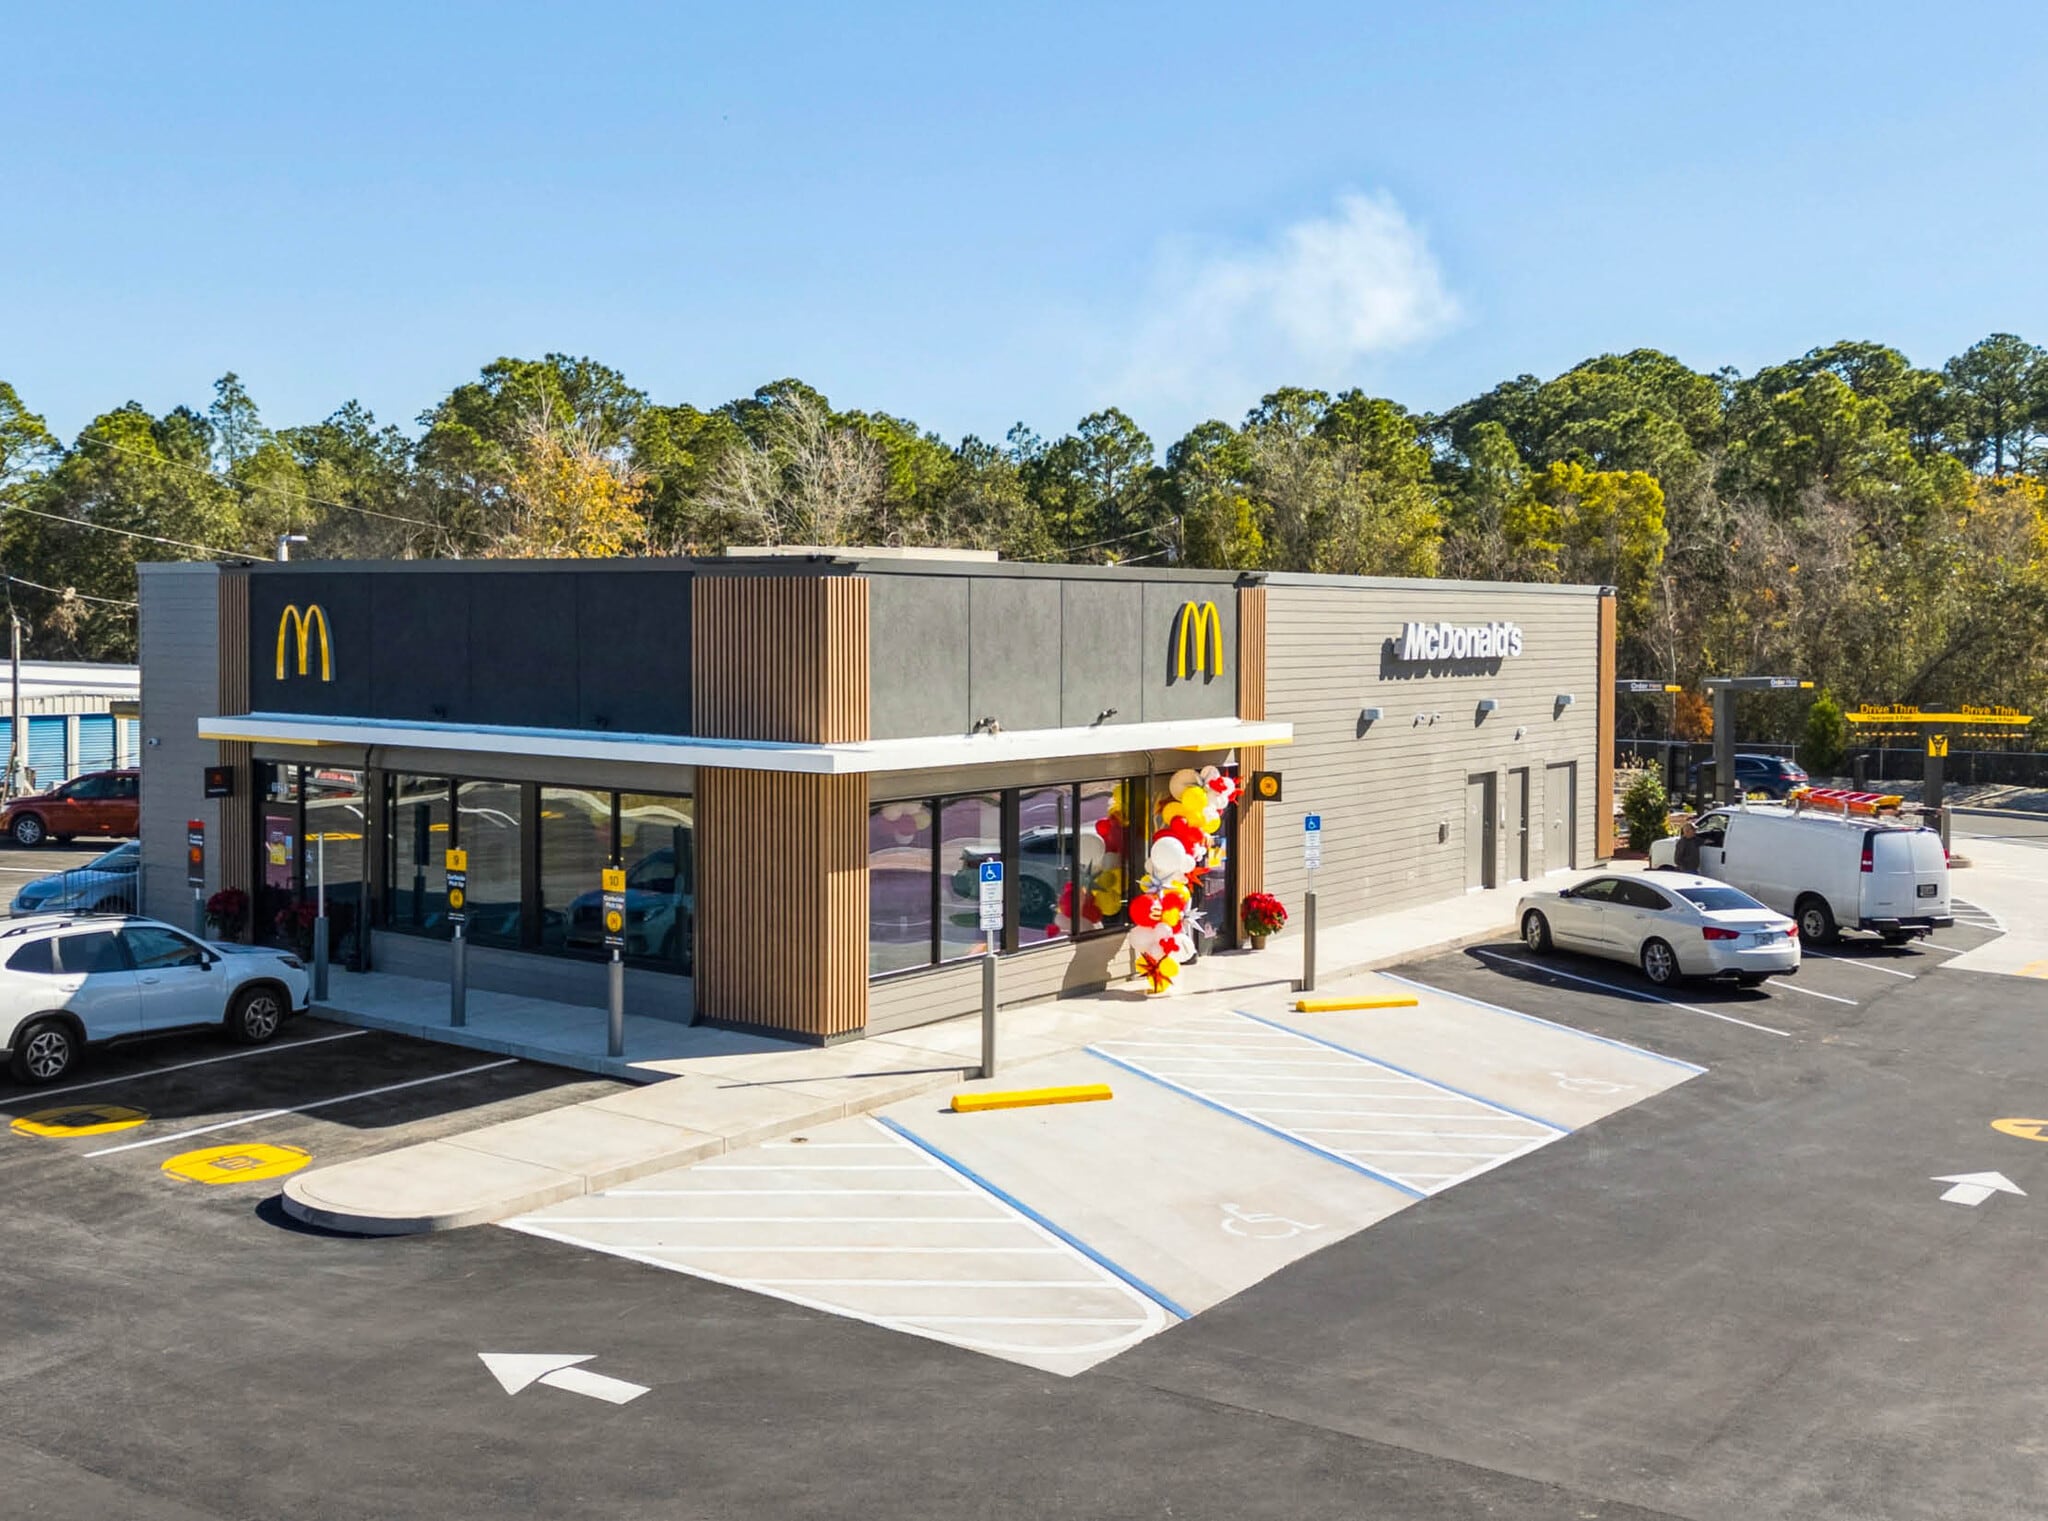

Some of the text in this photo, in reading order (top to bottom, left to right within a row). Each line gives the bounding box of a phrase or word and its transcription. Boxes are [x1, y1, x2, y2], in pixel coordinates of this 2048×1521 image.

[1403, 622, 1522, 660] McDonald's
[1860, 703, 1919, 714] Drive Thru
[1962, 704, 2020, 716] Drive Thru
[609, 875, 619, 887] 10
